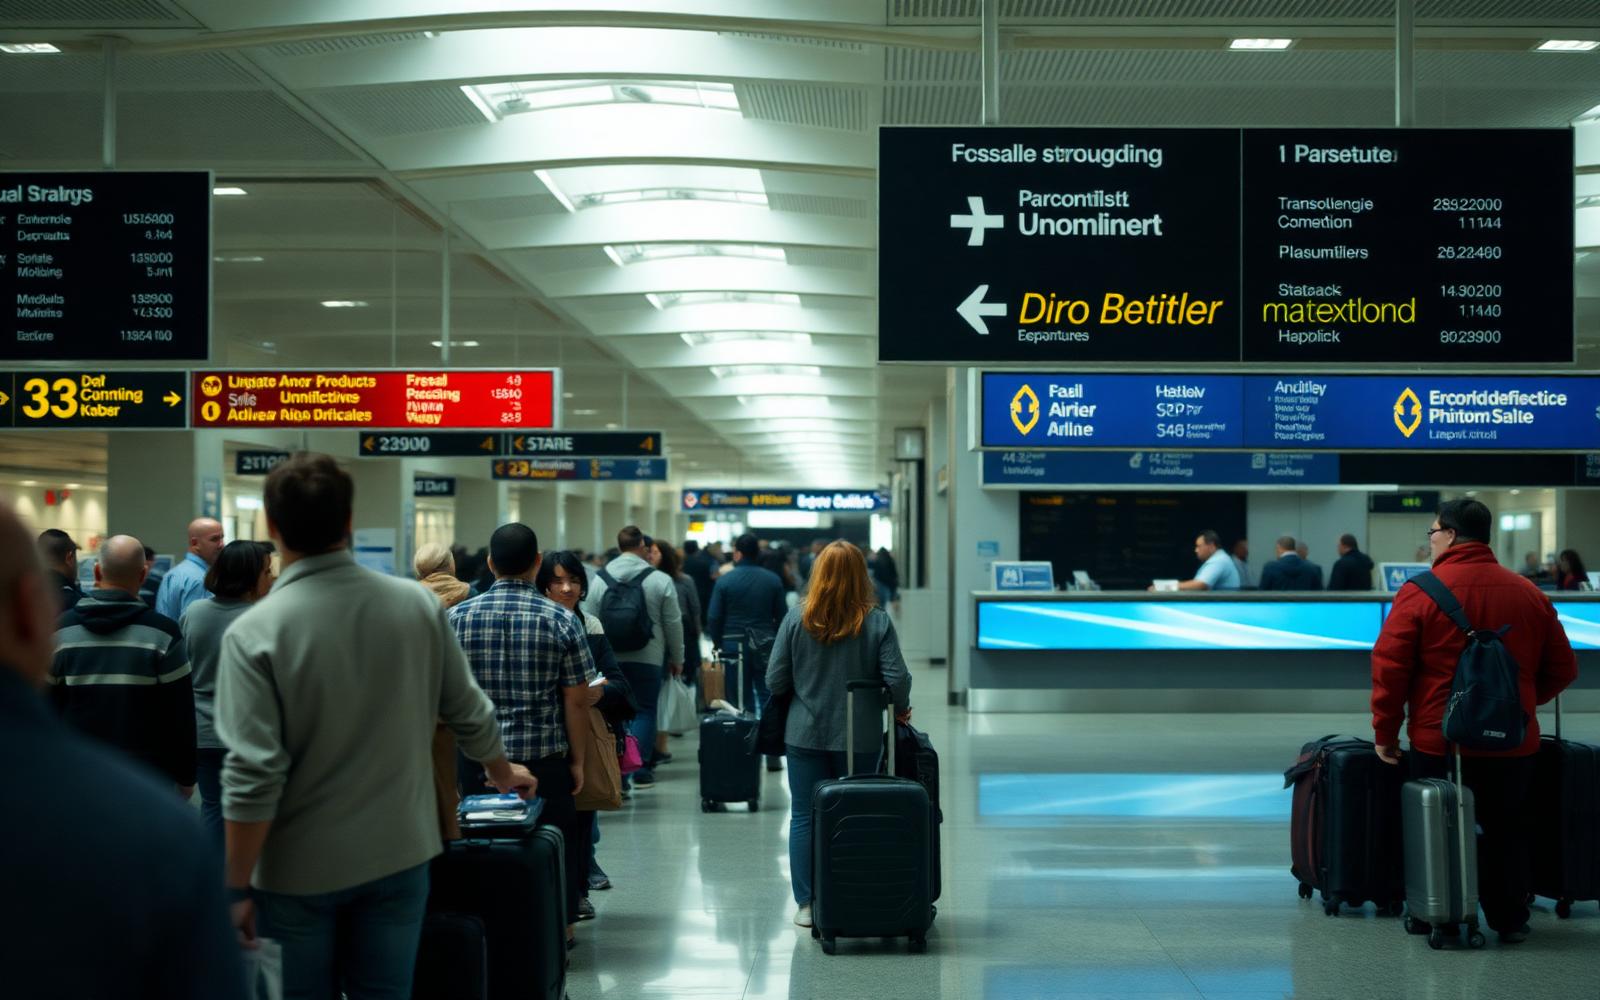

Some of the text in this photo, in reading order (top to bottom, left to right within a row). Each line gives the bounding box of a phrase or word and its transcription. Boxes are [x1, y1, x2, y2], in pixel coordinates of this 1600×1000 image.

[1019, 292, 1224, 325] Diro Betitler
[1263, 297, 1417, 324] matextlond
[316, 374, 377, 388] Products
[22, 377, 79, 419] 33
